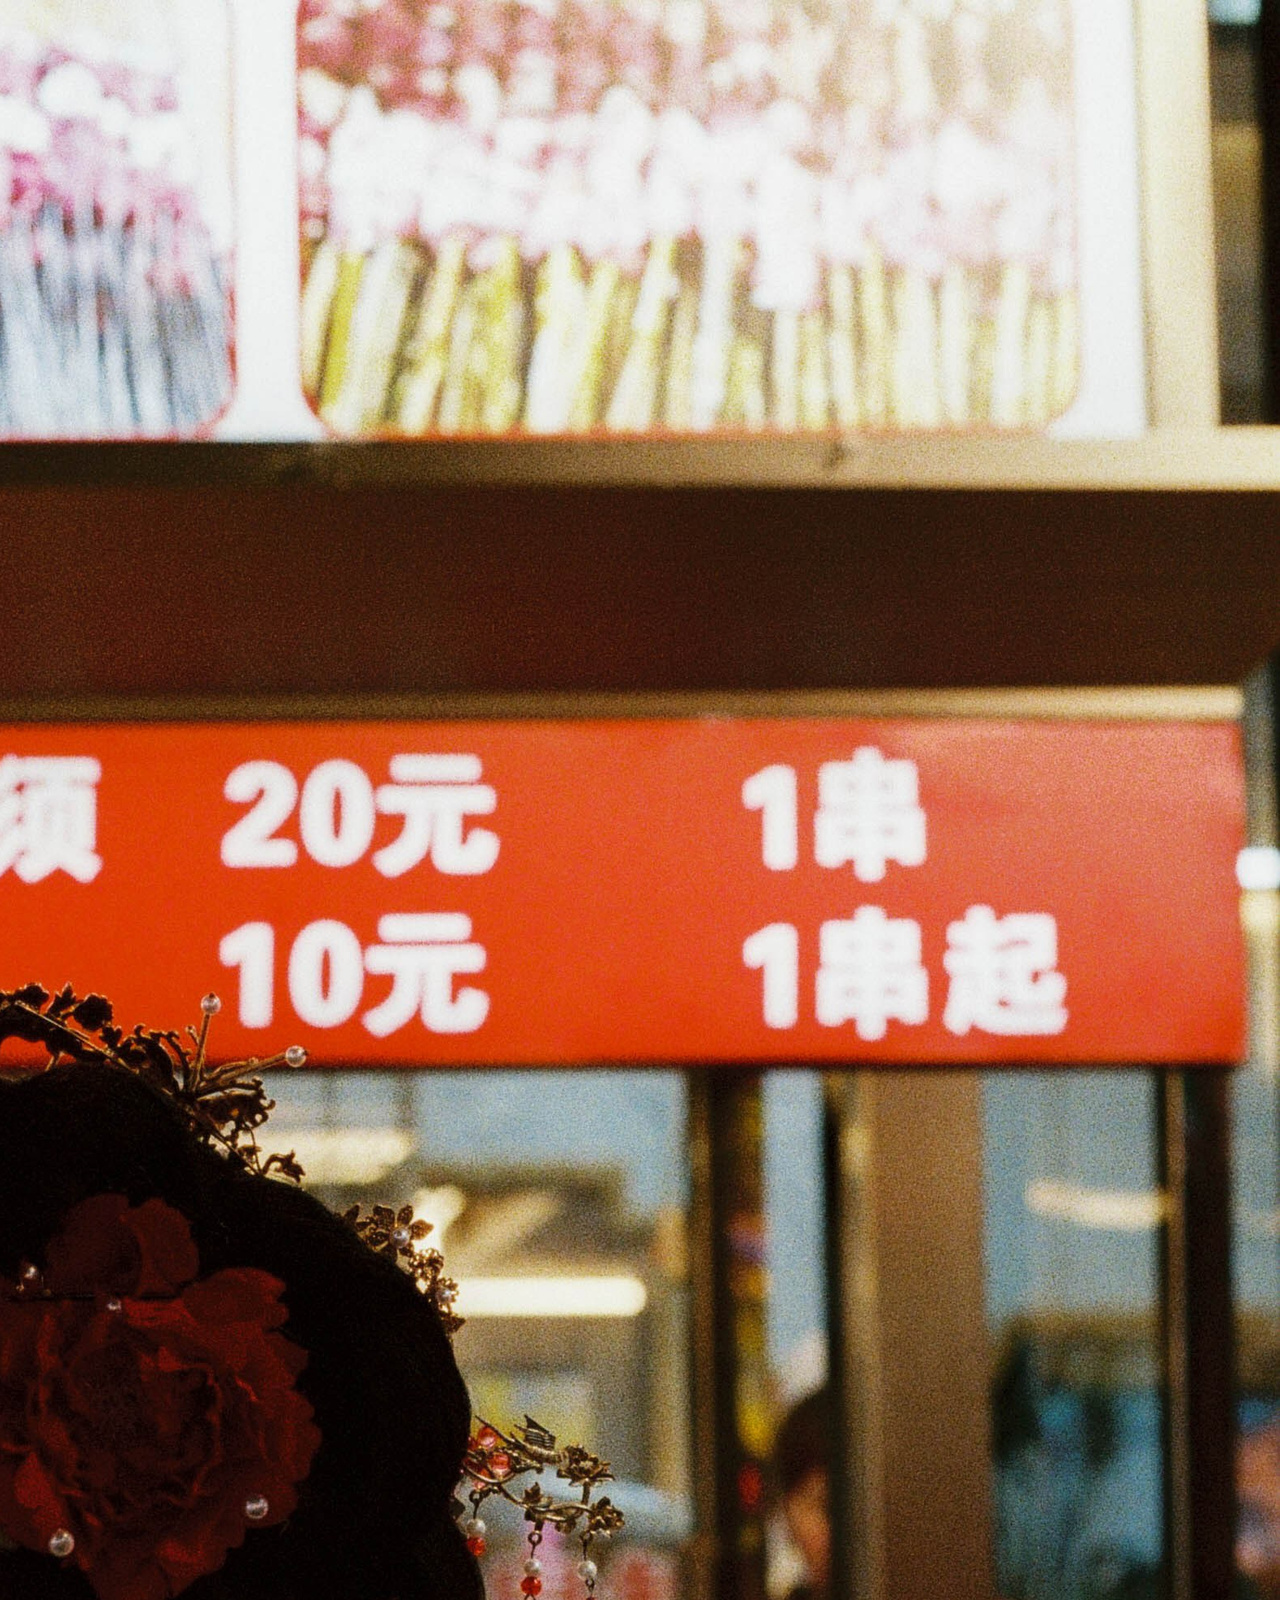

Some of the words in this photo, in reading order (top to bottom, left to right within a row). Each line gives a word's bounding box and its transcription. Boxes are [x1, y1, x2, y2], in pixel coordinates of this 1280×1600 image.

[220, 753, 501, 878] 20元
[740, 744, 928, 884] 1串
[219, 911, 490, 1037] 10元
[741, 903, 1069, 1041] 1串起
